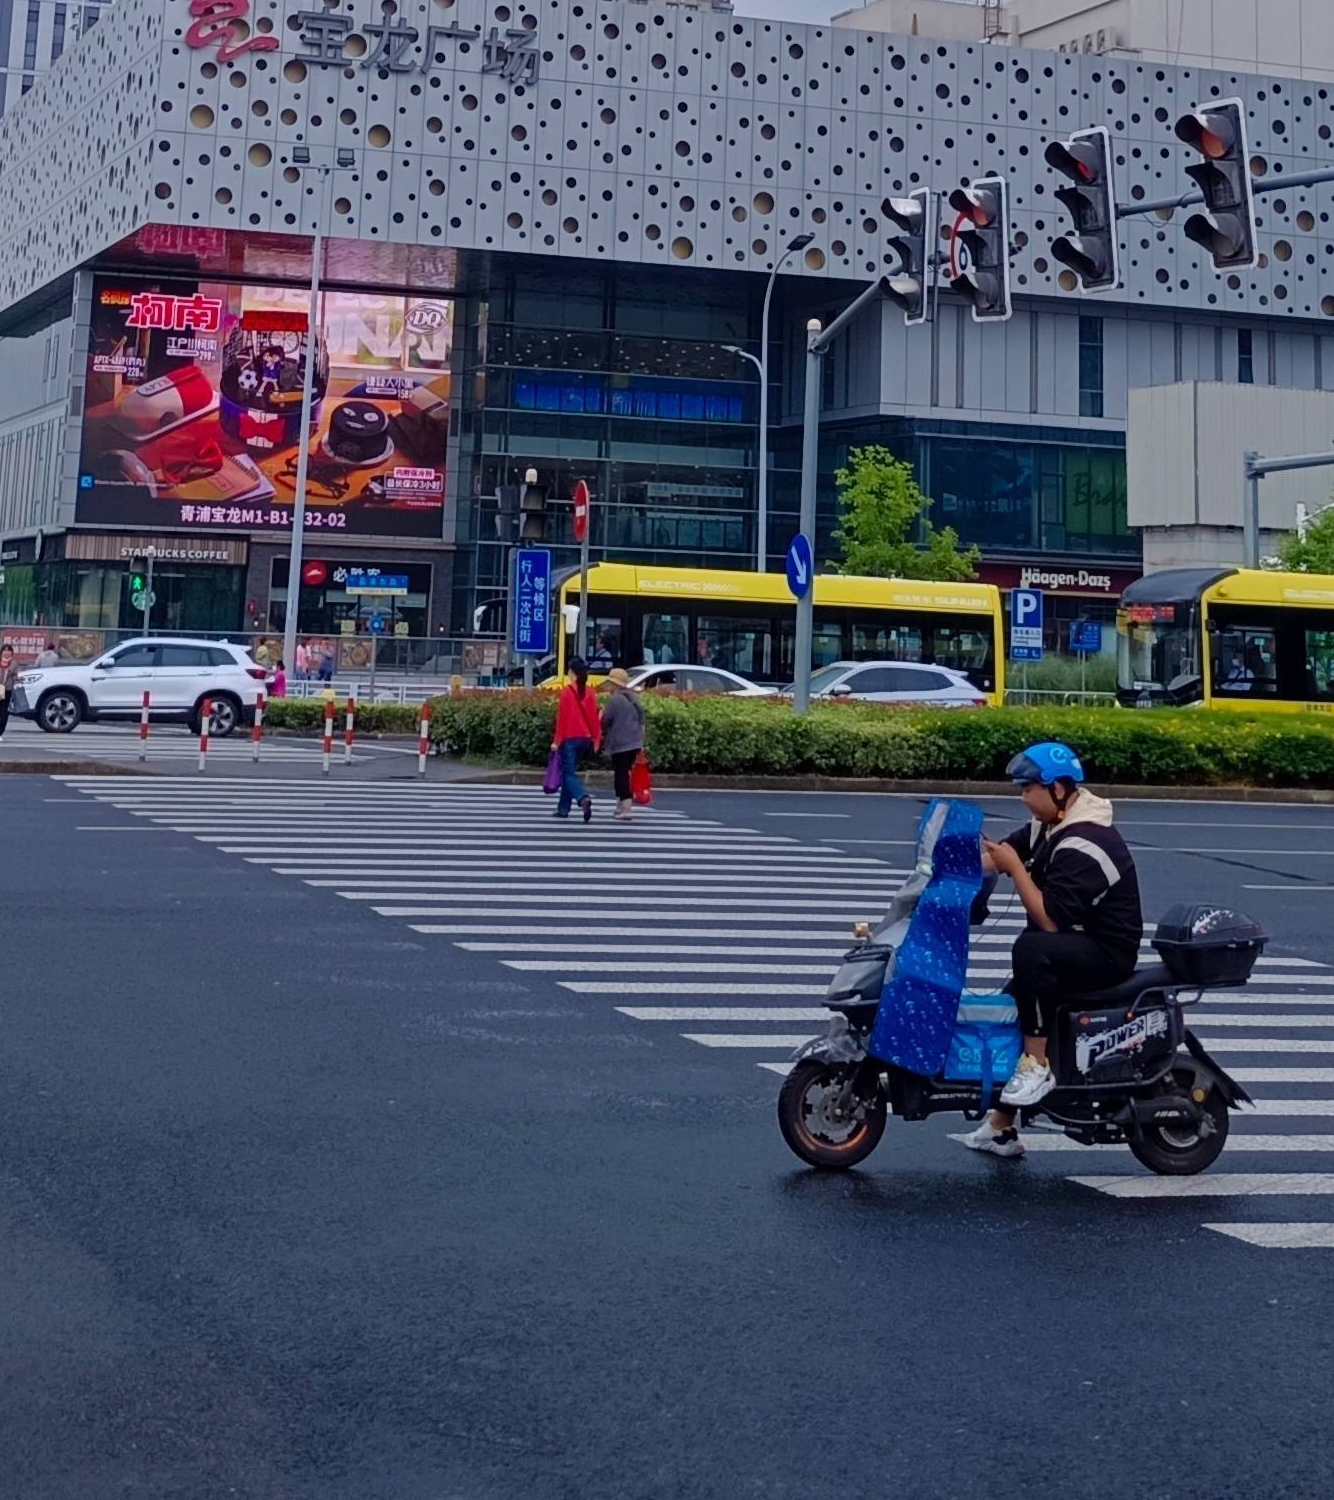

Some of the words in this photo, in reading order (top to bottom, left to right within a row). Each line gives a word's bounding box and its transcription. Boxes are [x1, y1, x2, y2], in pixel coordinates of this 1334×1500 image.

[295, 5, 541, 86] 宝龙广场
[126, 292, 222, 333] 柯南
[412, 310, 443, 327] DQ
[179, 503, 347, 529] 青浦宝龙M1-B1-32-02
[120, 546, 187, 559] STARUCKS
[187, 549, 229, 560] COFFEE
[519, 560, 533, 644] 行人二次过街
[533, 576, 546, 622] 等候区
[1016, 592, 1037, 625] P
